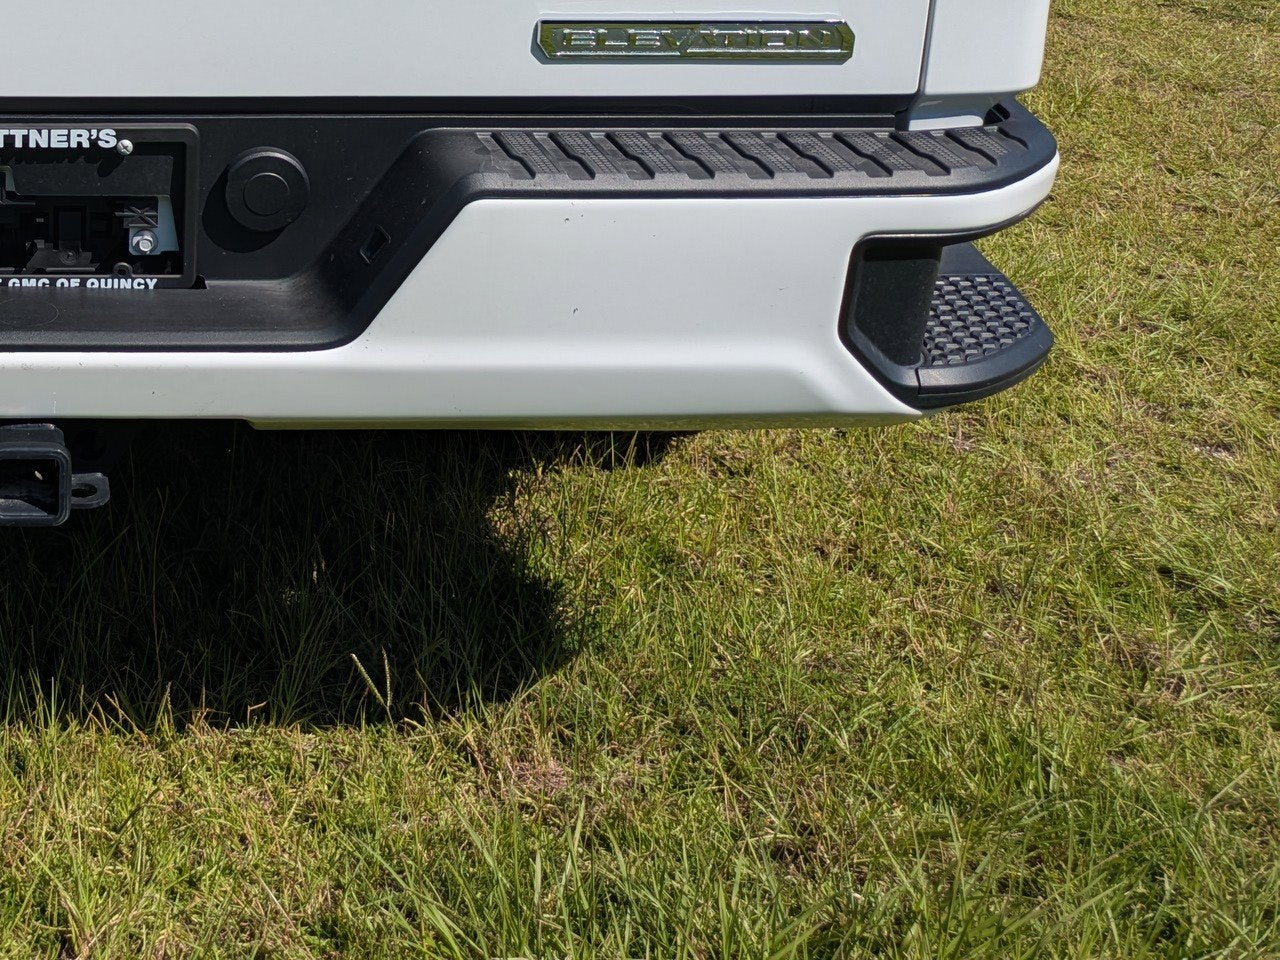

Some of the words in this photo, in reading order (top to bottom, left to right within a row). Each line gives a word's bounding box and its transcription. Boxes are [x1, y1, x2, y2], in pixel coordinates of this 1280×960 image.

[560, 25, 836, 51] ELEVATION
[7, 277, 50, 288] GMC
[55, 277, 81, 288] OF
[86, 277, 159, 290] QUINCY
